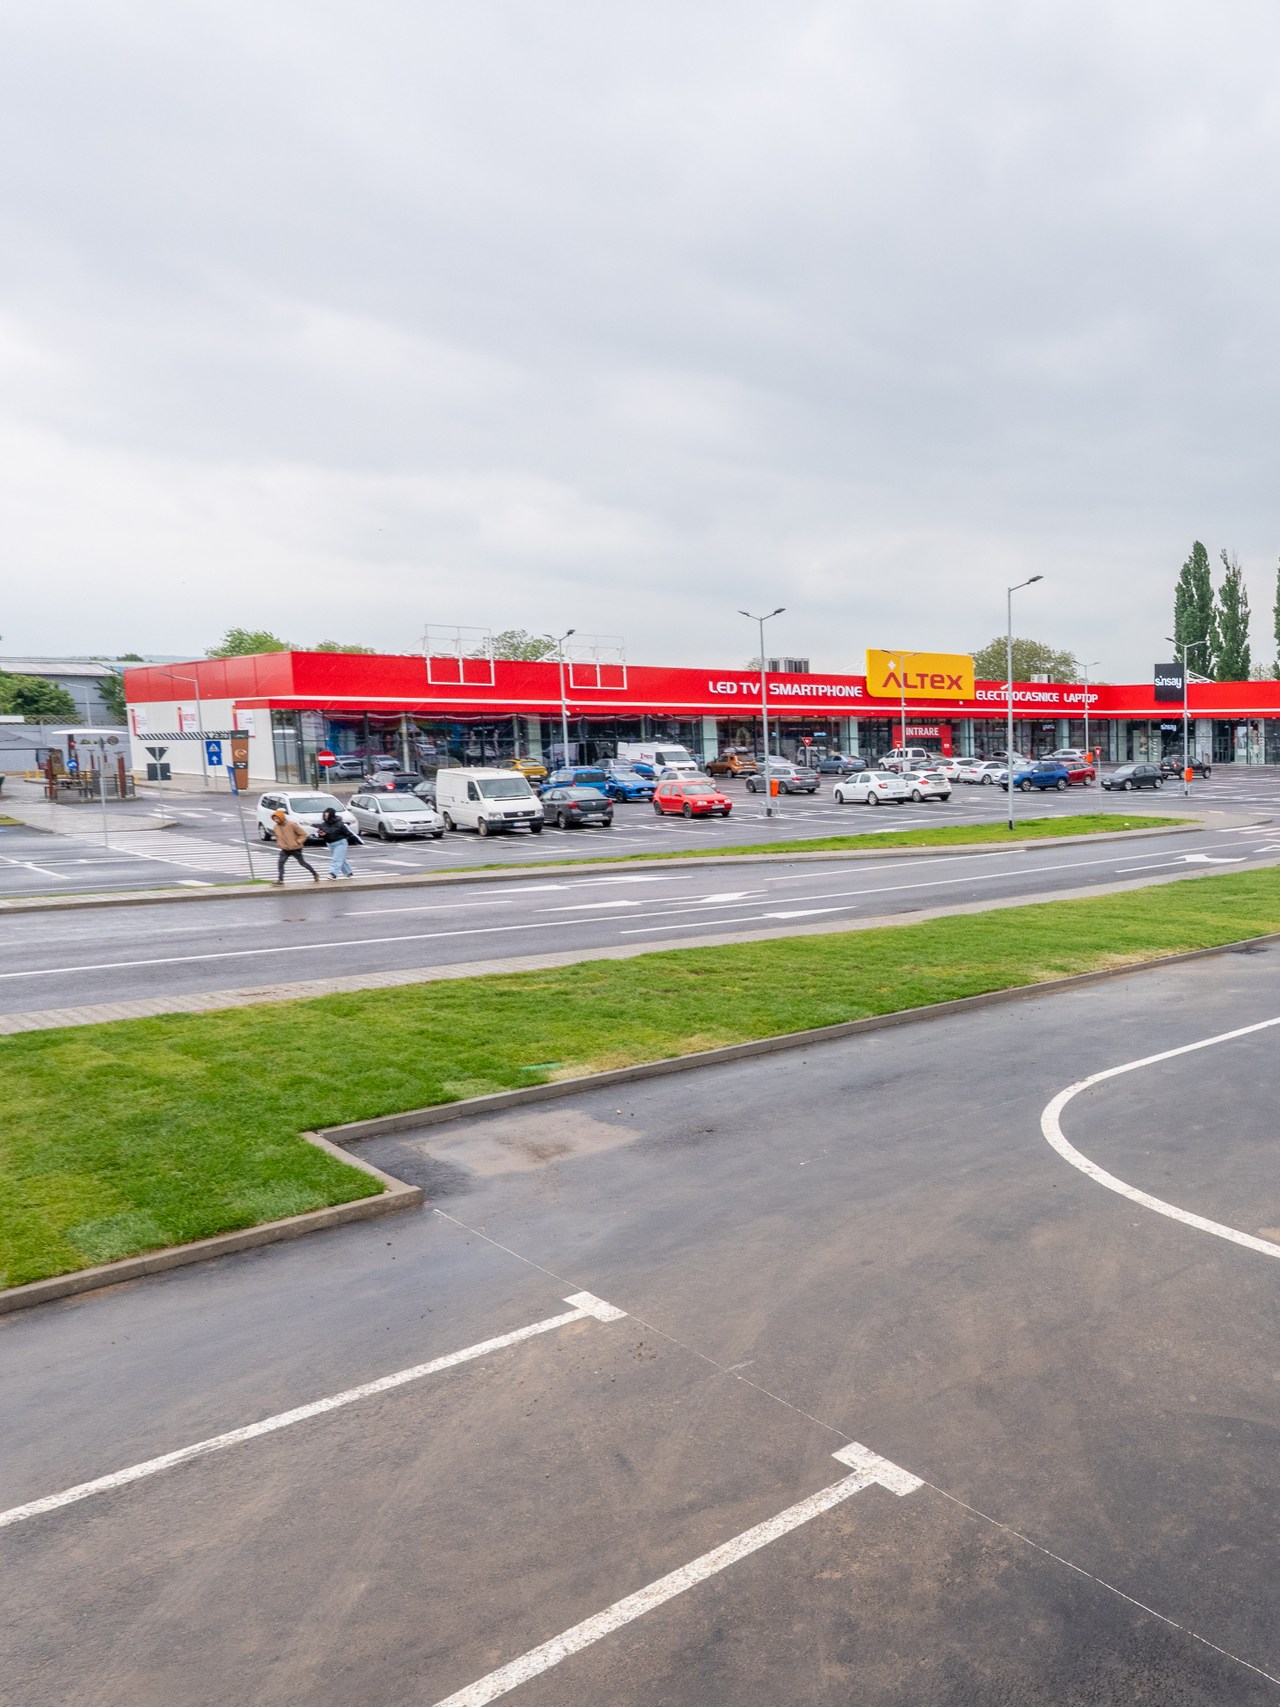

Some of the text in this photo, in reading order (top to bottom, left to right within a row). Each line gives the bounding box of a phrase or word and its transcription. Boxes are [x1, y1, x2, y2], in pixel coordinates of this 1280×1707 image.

[1155, 676, 1182, 688] sinsay
[708, 681, 863, 697] LED TV SMARTPHONE
[976, 690, 1098, 703] ELECTOCASNICE LAPTOP
[905, 727, 939, 736] INTRARE
